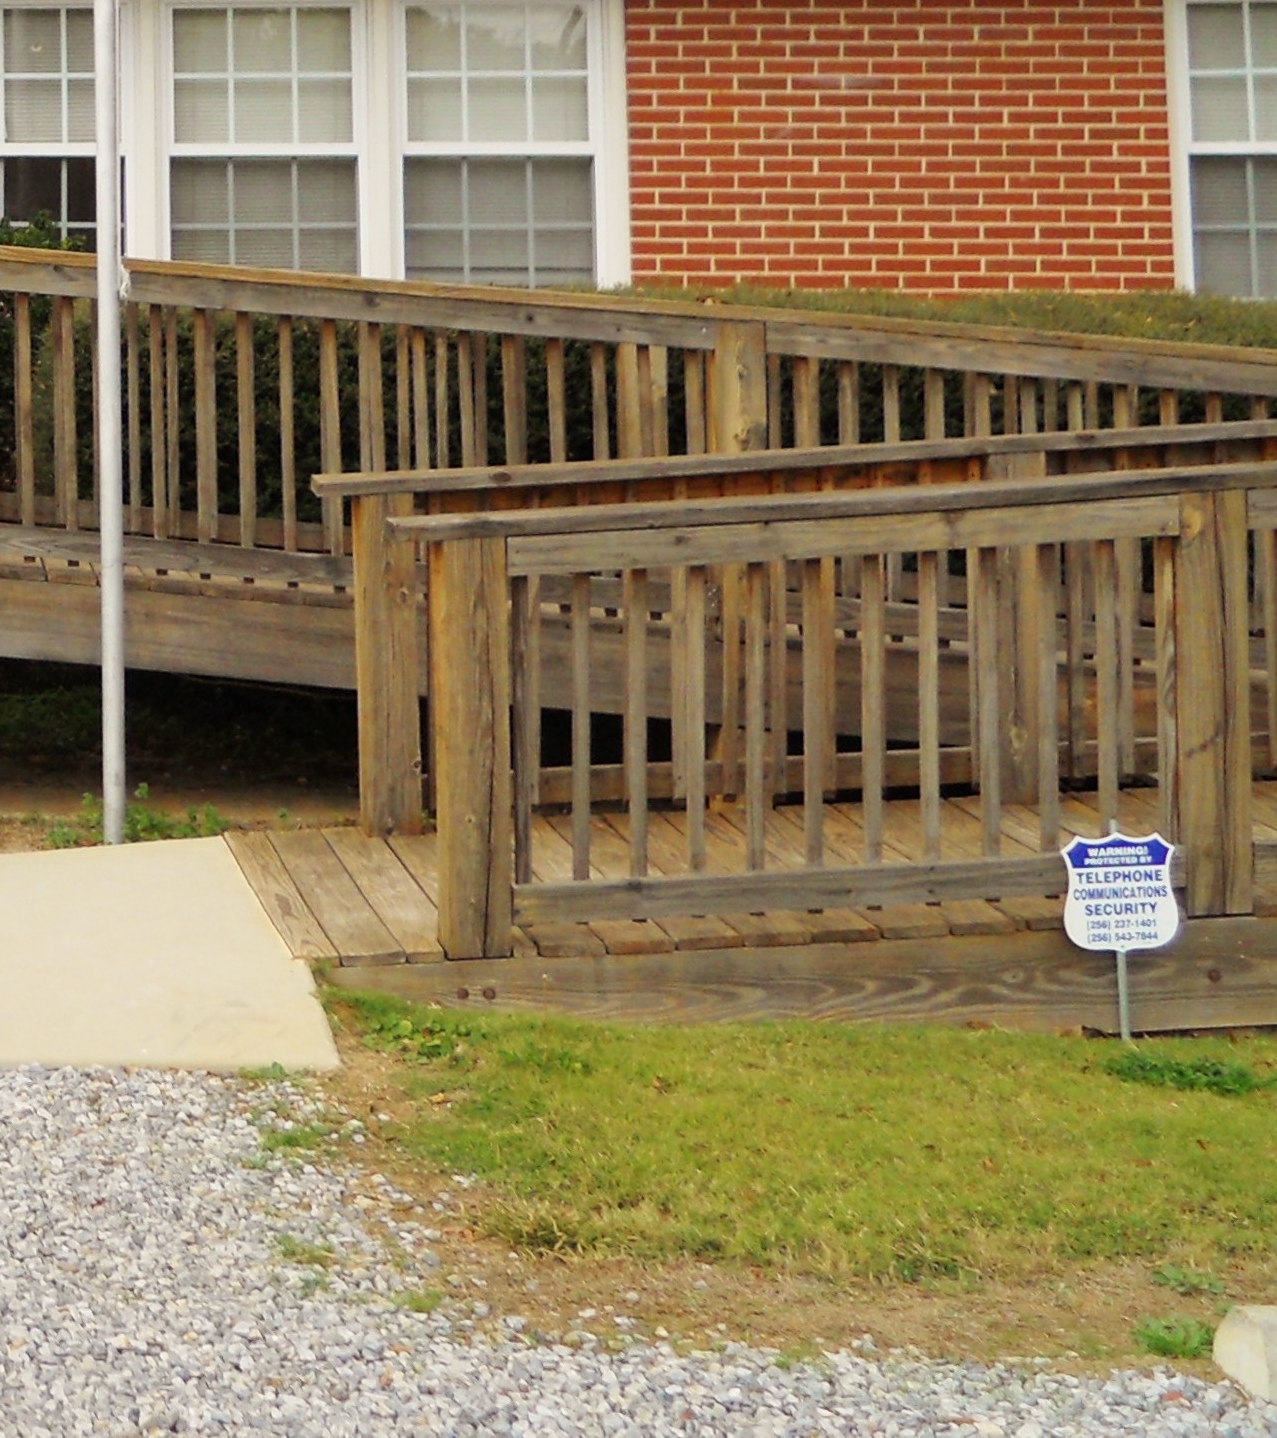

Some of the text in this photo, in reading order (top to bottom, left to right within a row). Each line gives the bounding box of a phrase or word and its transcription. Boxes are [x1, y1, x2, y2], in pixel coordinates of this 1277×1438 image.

[1087, 846, 1149, 857] WARNING!
[1084, 855, 1152, 866] PROTECTED BY
[1076, 869, 1163, 884] TELEPHONE
[1073, 885, 1168, 901] COMMUNICATIONS
[1084, 902, 1158, 917] SECURITY
[1087, 919, 1111, 931] (256)
[1087, 932, 1112, 944] (256)
